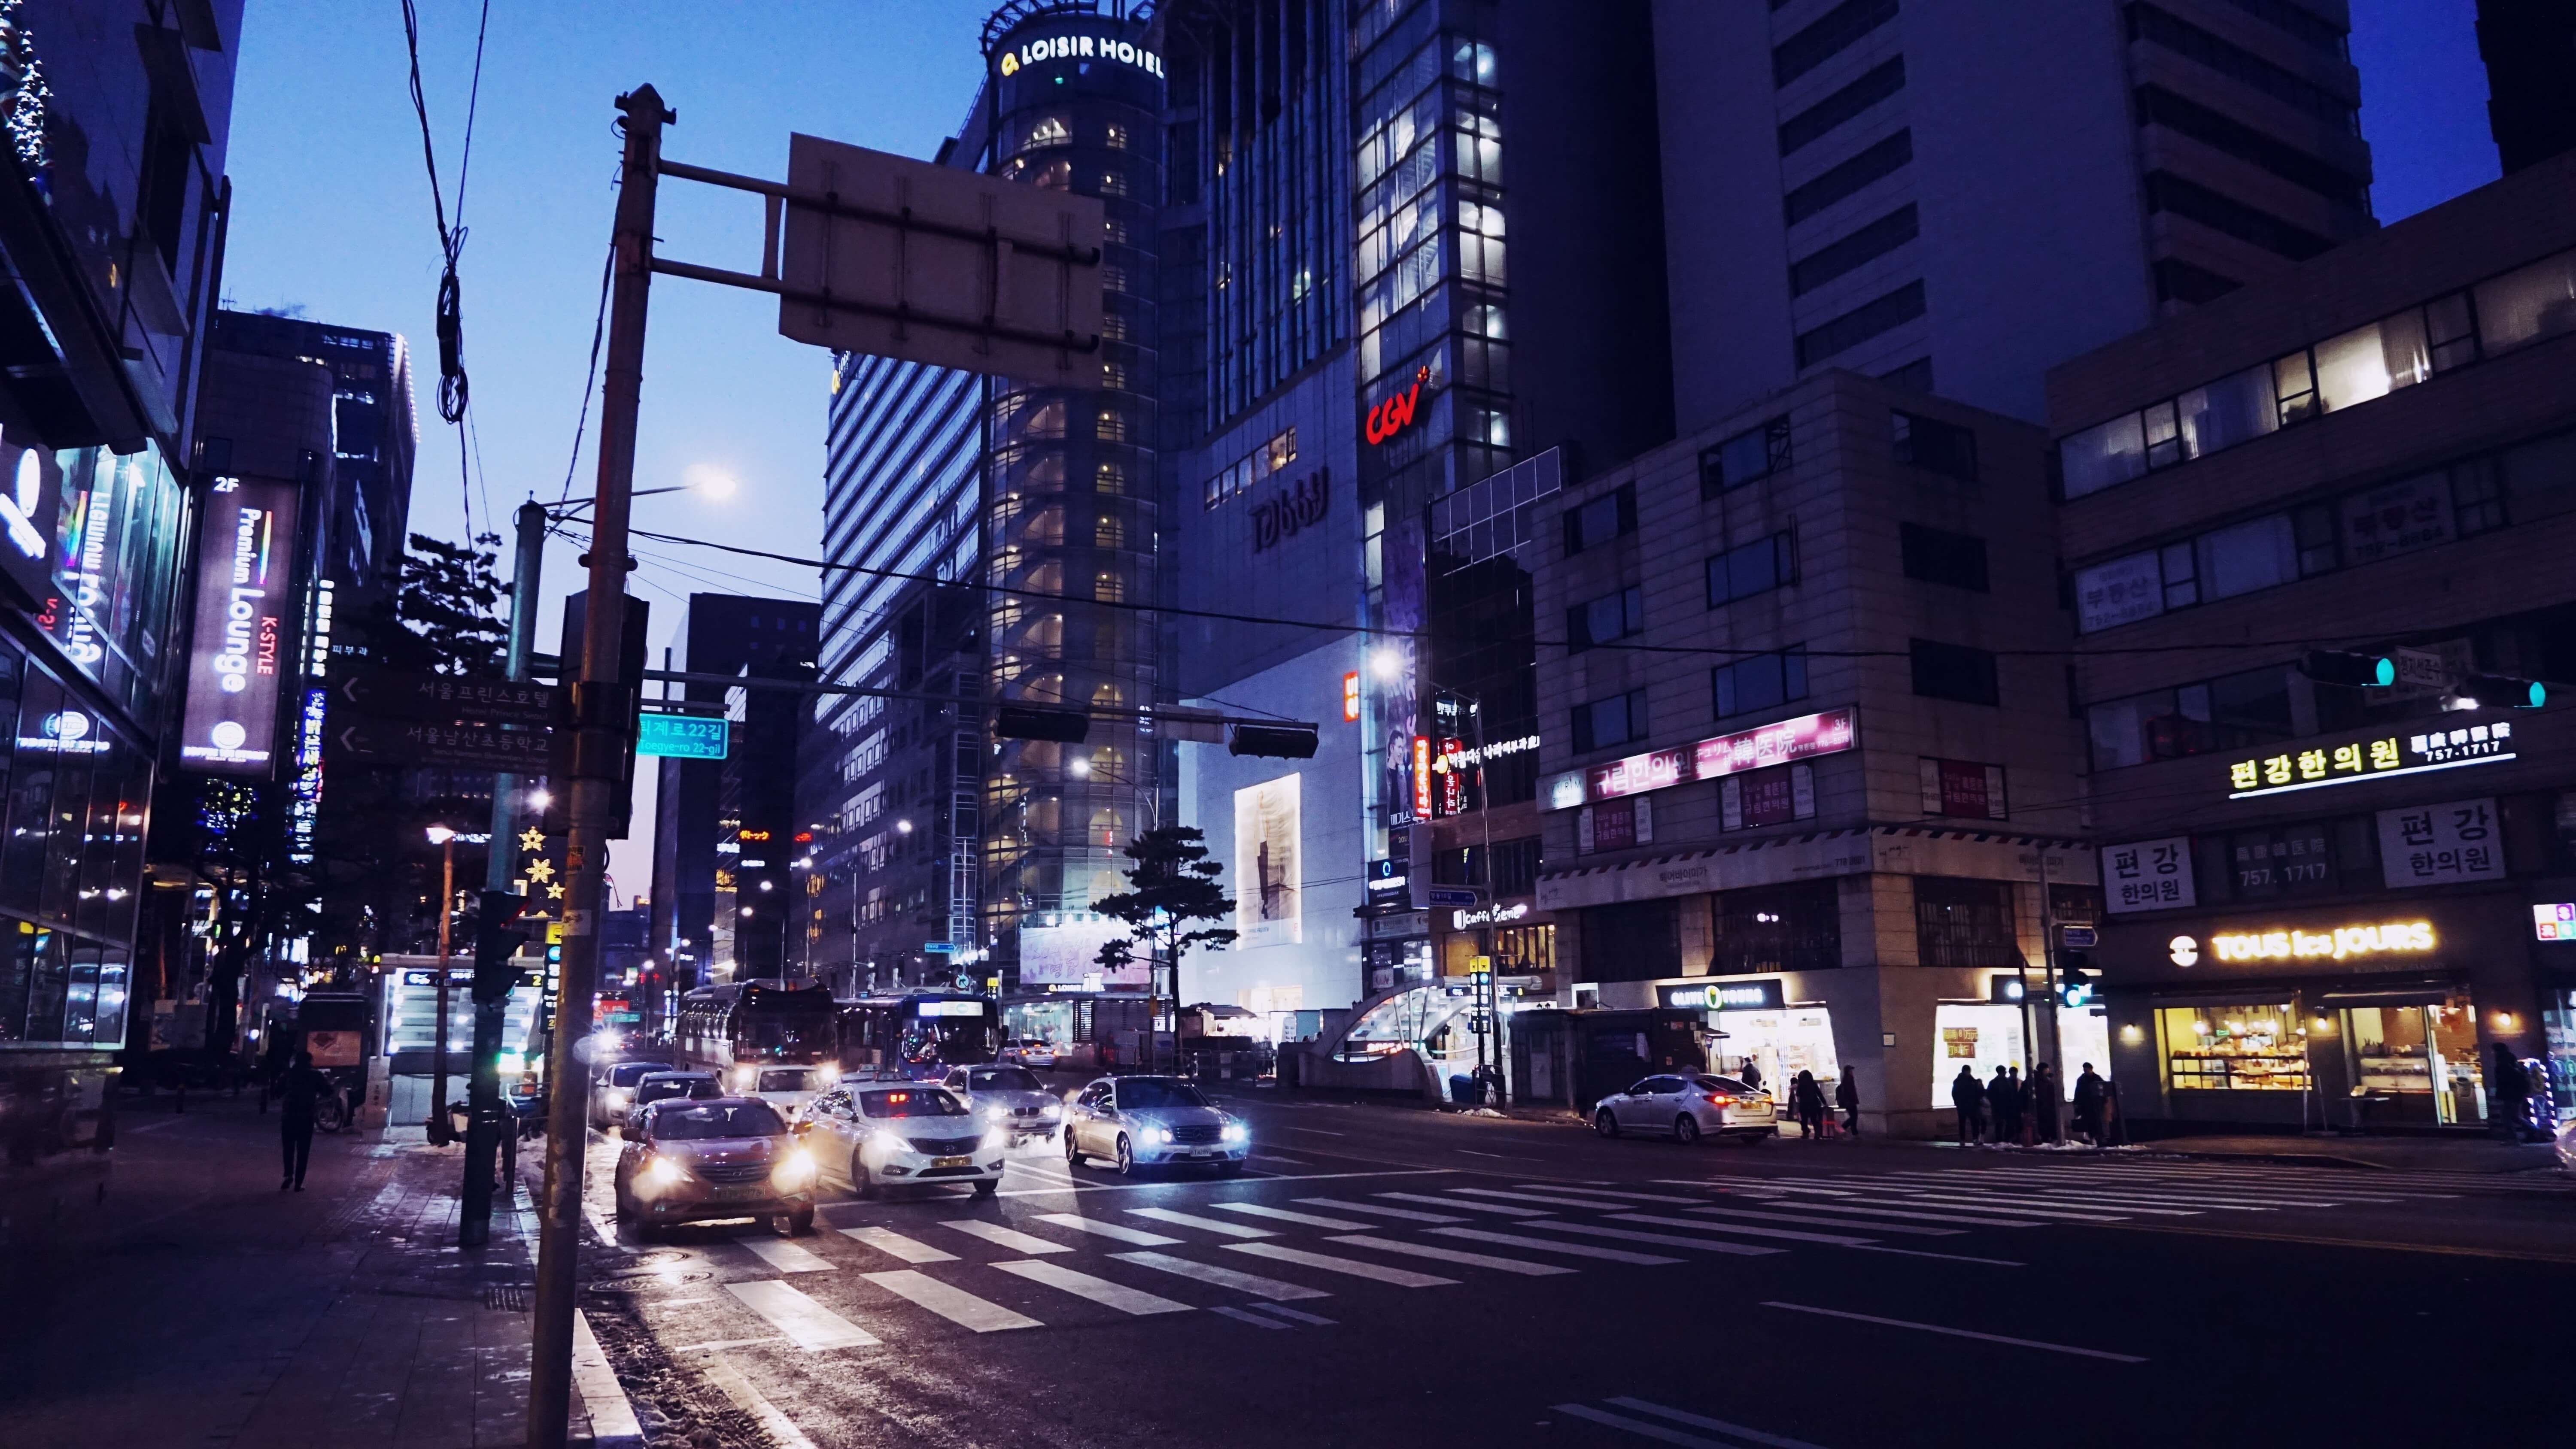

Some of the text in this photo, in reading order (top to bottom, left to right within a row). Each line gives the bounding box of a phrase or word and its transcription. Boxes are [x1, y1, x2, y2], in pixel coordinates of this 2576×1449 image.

[1022, 36, 1094, 65] LOISIR
[1367, 383, 1419, 445] CGV
[214, 477, 239, 492] 2F
[215, 508, 264, 693] Premium Lounge
[257, 616, 278, 675] K-STYLE
[332, 645, 368, 656] 피부과
[419, 682, 549, 707] 서울프린스호텔
[1834, 718, 1847, 731] 3F
[407, 727, 549, 752] 서울남산초등학교
[640, 739, 720, 755] Toegye-ro 22-gil
[1733, 726, 1798, 766] 韓医院
[2425, 741, 2500, 762] 757-1717
[1594, 748, 1692, 795] 규림한의원
[2231, 737, 2400, 789] 편강한의원
[2284, 863, 2326, 882] 1717
[2409, 846, 2489, 877] 한의원
[2121, 879, 2181, 905] 한의원
[2213, 923, 2433, 959] TOUS les JOURS
[533, 975, 542, 986] 2
[1671, 988, 1762, 1006] OLIVE YOUNG
